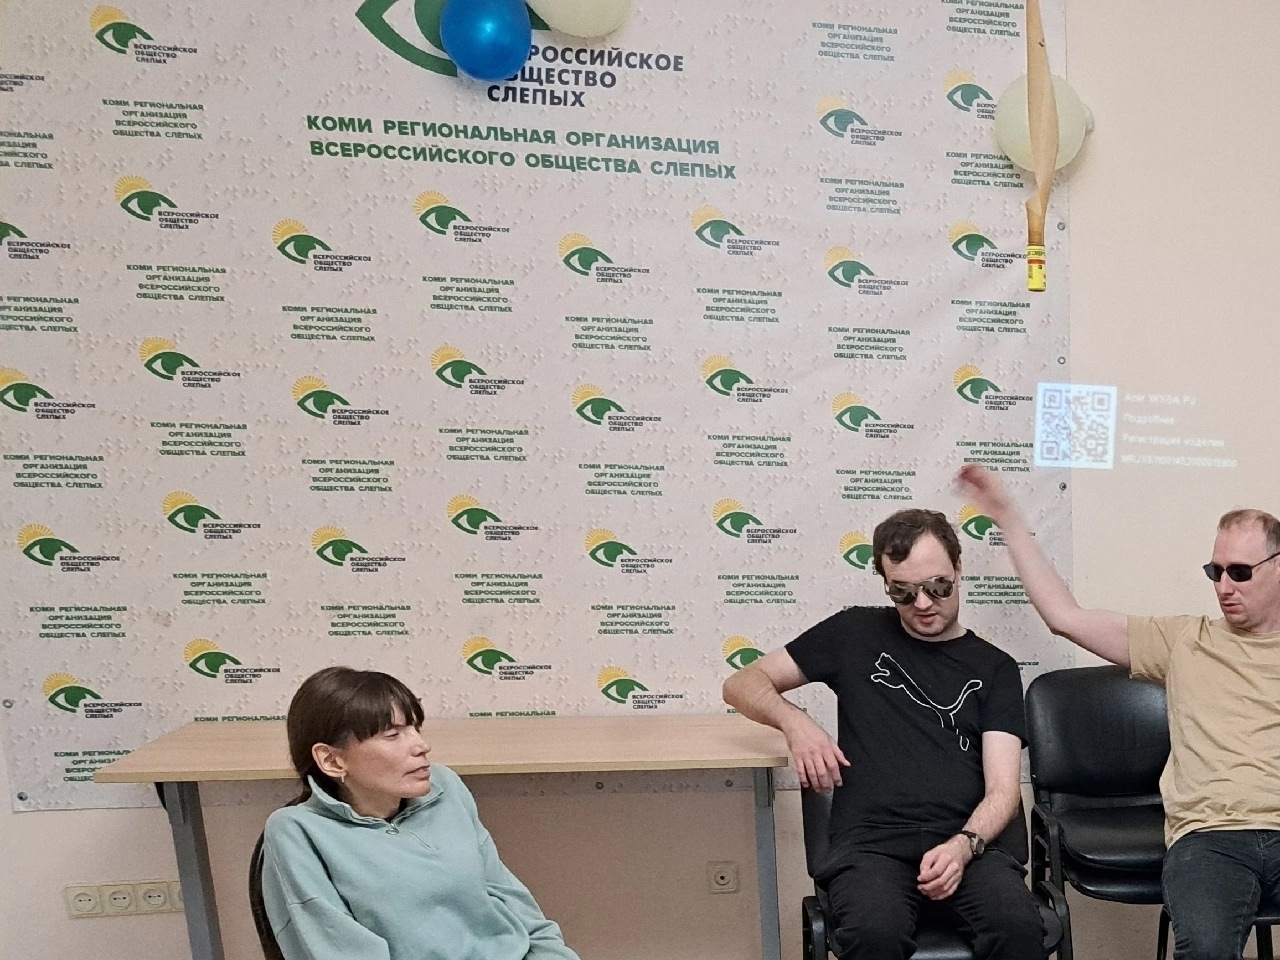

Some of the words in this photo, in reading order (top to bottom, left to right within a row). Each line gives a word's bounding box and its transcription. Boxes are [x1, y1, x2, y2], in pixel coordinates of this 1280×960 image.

[529, 45, 684, 72] РОССИЙСКОЕ
[503, 65, 617, 88] ЩЕСТВО
[487, 84, 585, 108] СЛЕПЫХ
[133, 101, 204, 111] РЕГИОНАЛЬНАЯ
[115, 120, 197, 129] ВСЕРОССИЙСКОГО
[112, 129, 162, 137] ОБЩЕСТВА
[306, 114, 373, 133] КОМИ
[383, 119, 556, 144] РЕГИОНАЛЬНАЯ
[565, 131, 719, 155] ОРГАНИЗАЦИЯ
[309, 140, 516, 167] ВСЕРОССИЙСКОГО
[524, 152, 642, 174] ОБЩЕСТВА
[650, 160, 737, 179] СЛЕПЫХ
[156, 265, 227, 274] РЕГИОНАЛЬНАЯ
[450, 277, 515, 285] РЕГИОНАЛЬНАЯ
[138, 283, 220, 292] ВСЕРОССИЙСКОГО
[722, 289, 782, 297] РЕГИОНАЛЬНАЯ
[432, 295, 508, 303] ВСЕРОССИЙСКОГО
[430, 303, 476, 311] ОБЩЕСТВА
[705, 306, 776, 314] ВСЕРОССИЙСКОГО
[293, 324, 371, 332] ВСЕРОССИЙСКОГО
[574, 334, 647, 342] ВСЕРОССИЙСКОГО
[837, 344, 904, 352] ВСЕРОССИЙСКОГО
